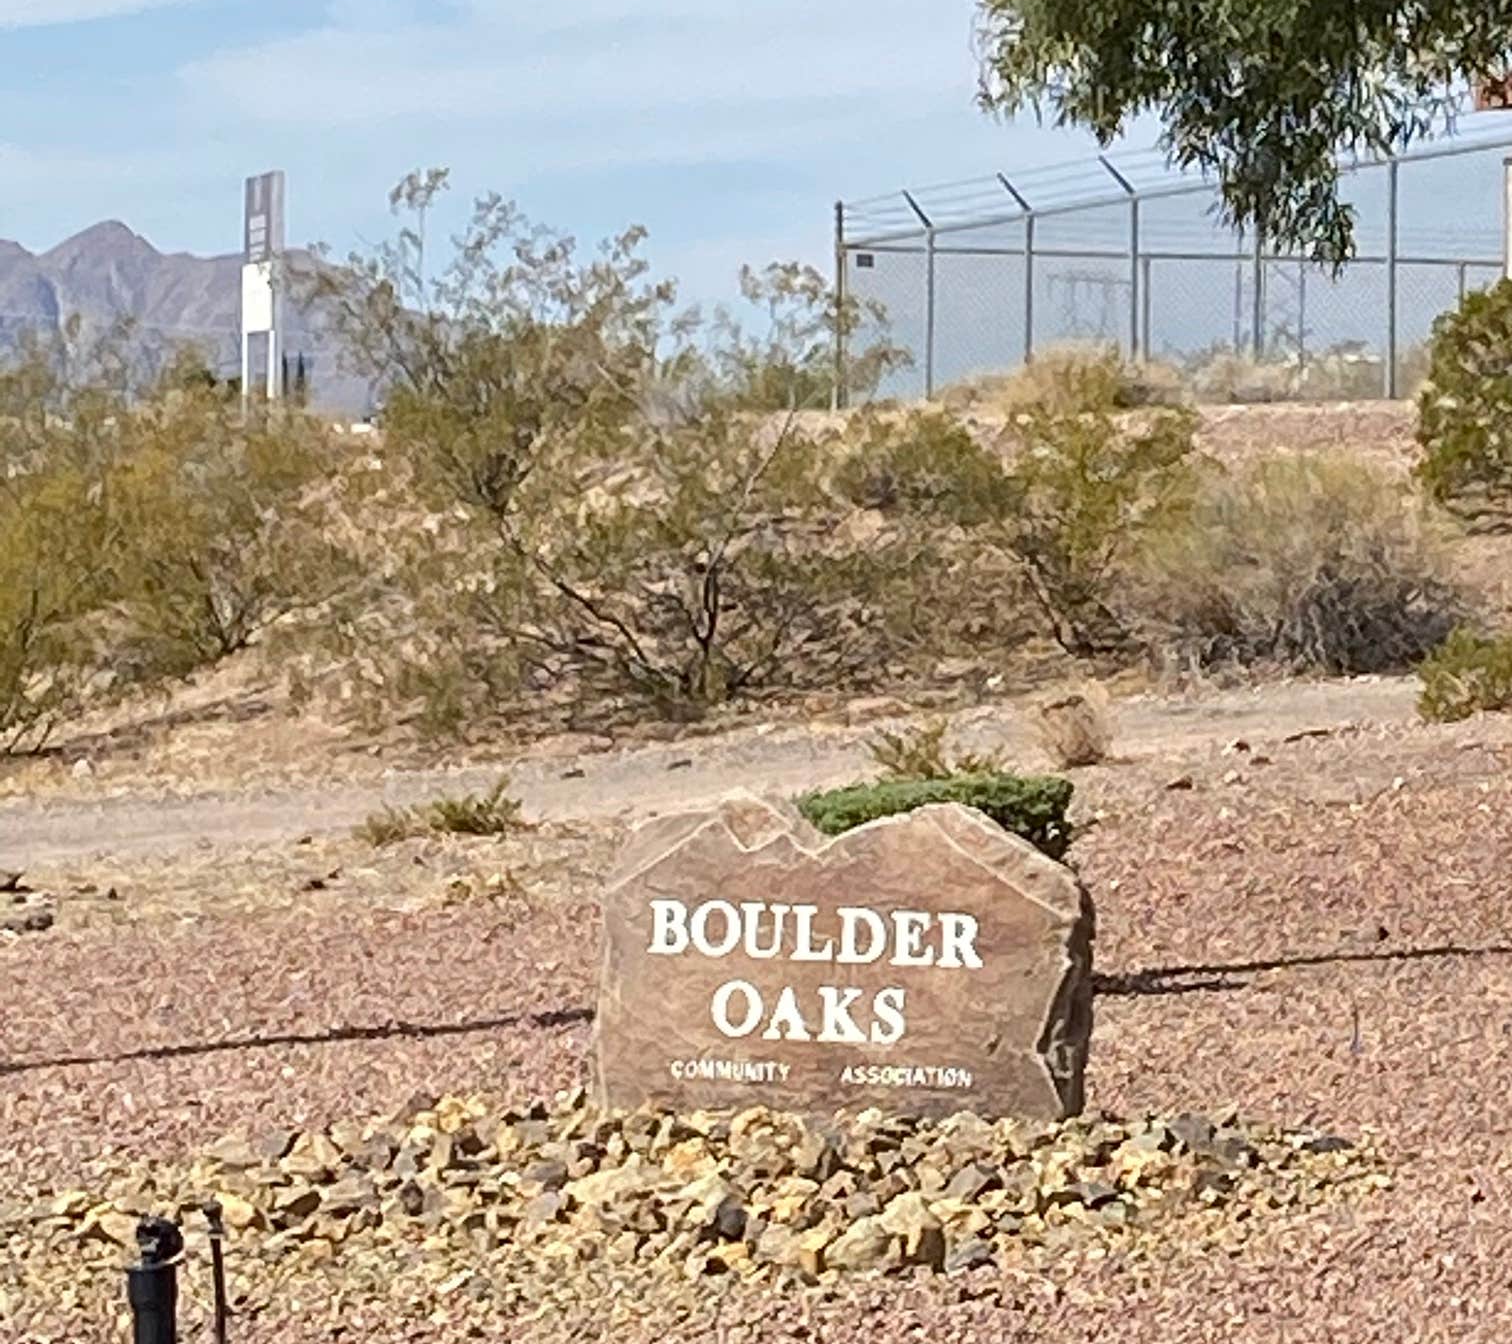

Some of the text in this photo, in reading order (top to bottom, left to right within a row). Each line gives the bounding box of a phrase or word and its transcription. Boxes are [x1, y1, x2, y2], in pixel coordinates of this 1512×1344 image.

[647, 898, 985, 969] BOULDER
[710, 979, 907, 1045] OAKS
[669, 1059, 974, 1088] COMMUNITY ASSOCIATION
